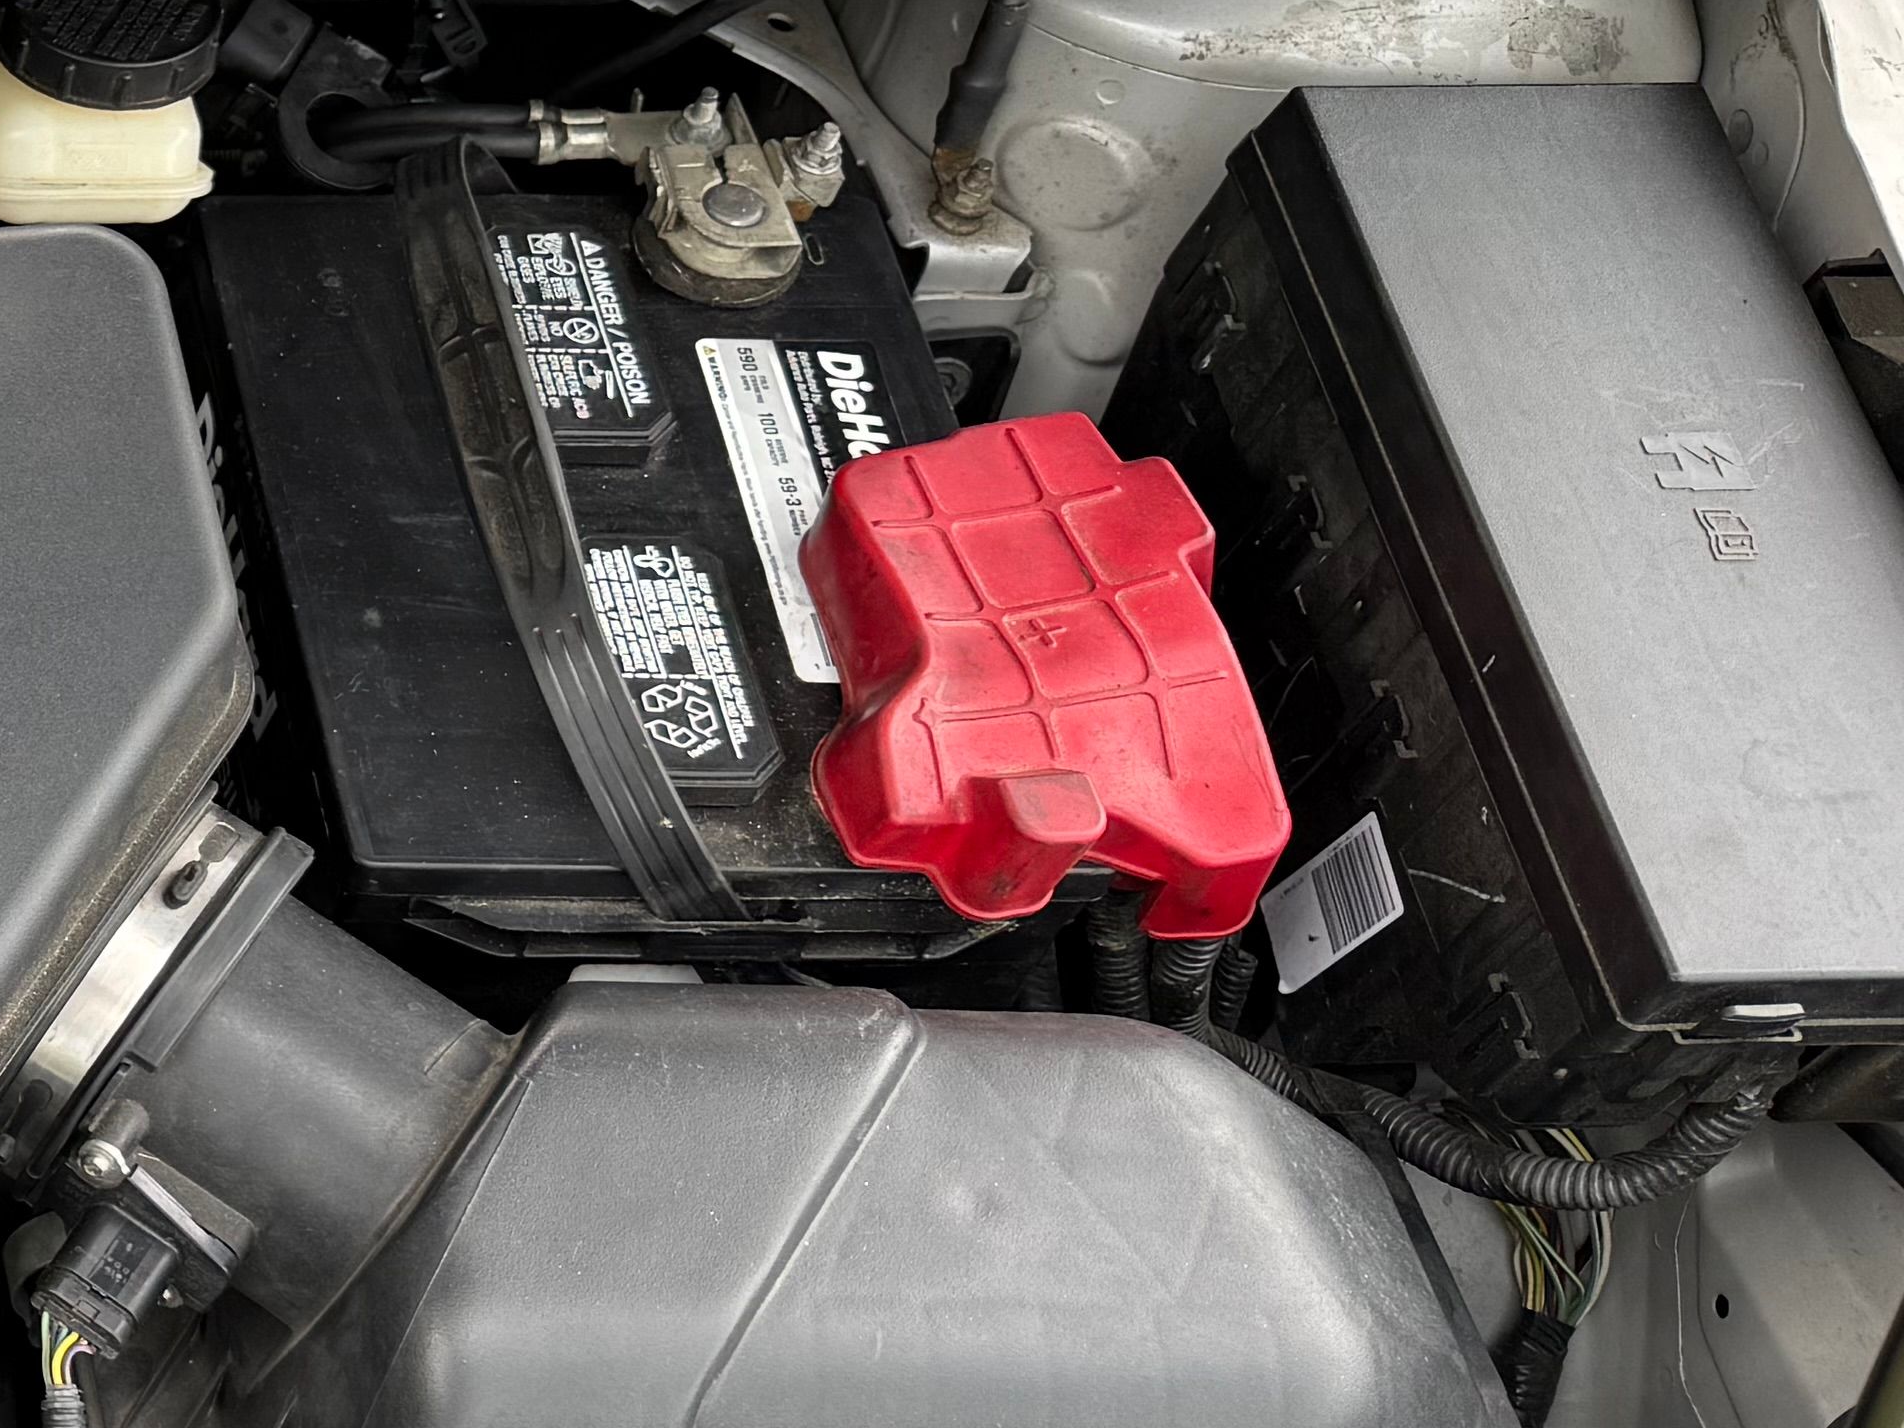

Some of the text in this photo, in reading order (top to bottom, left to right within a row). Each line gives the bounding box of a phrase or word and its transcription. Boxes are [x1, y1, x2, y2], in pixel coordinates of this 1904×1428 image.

[548, 321, 565, 337] NO
[586, 257, 624, 326] DANGER
[612, 342, 652, 405] POISON
[737, 347, 758, 372] 590
[758, 412, 778, 435] 100
